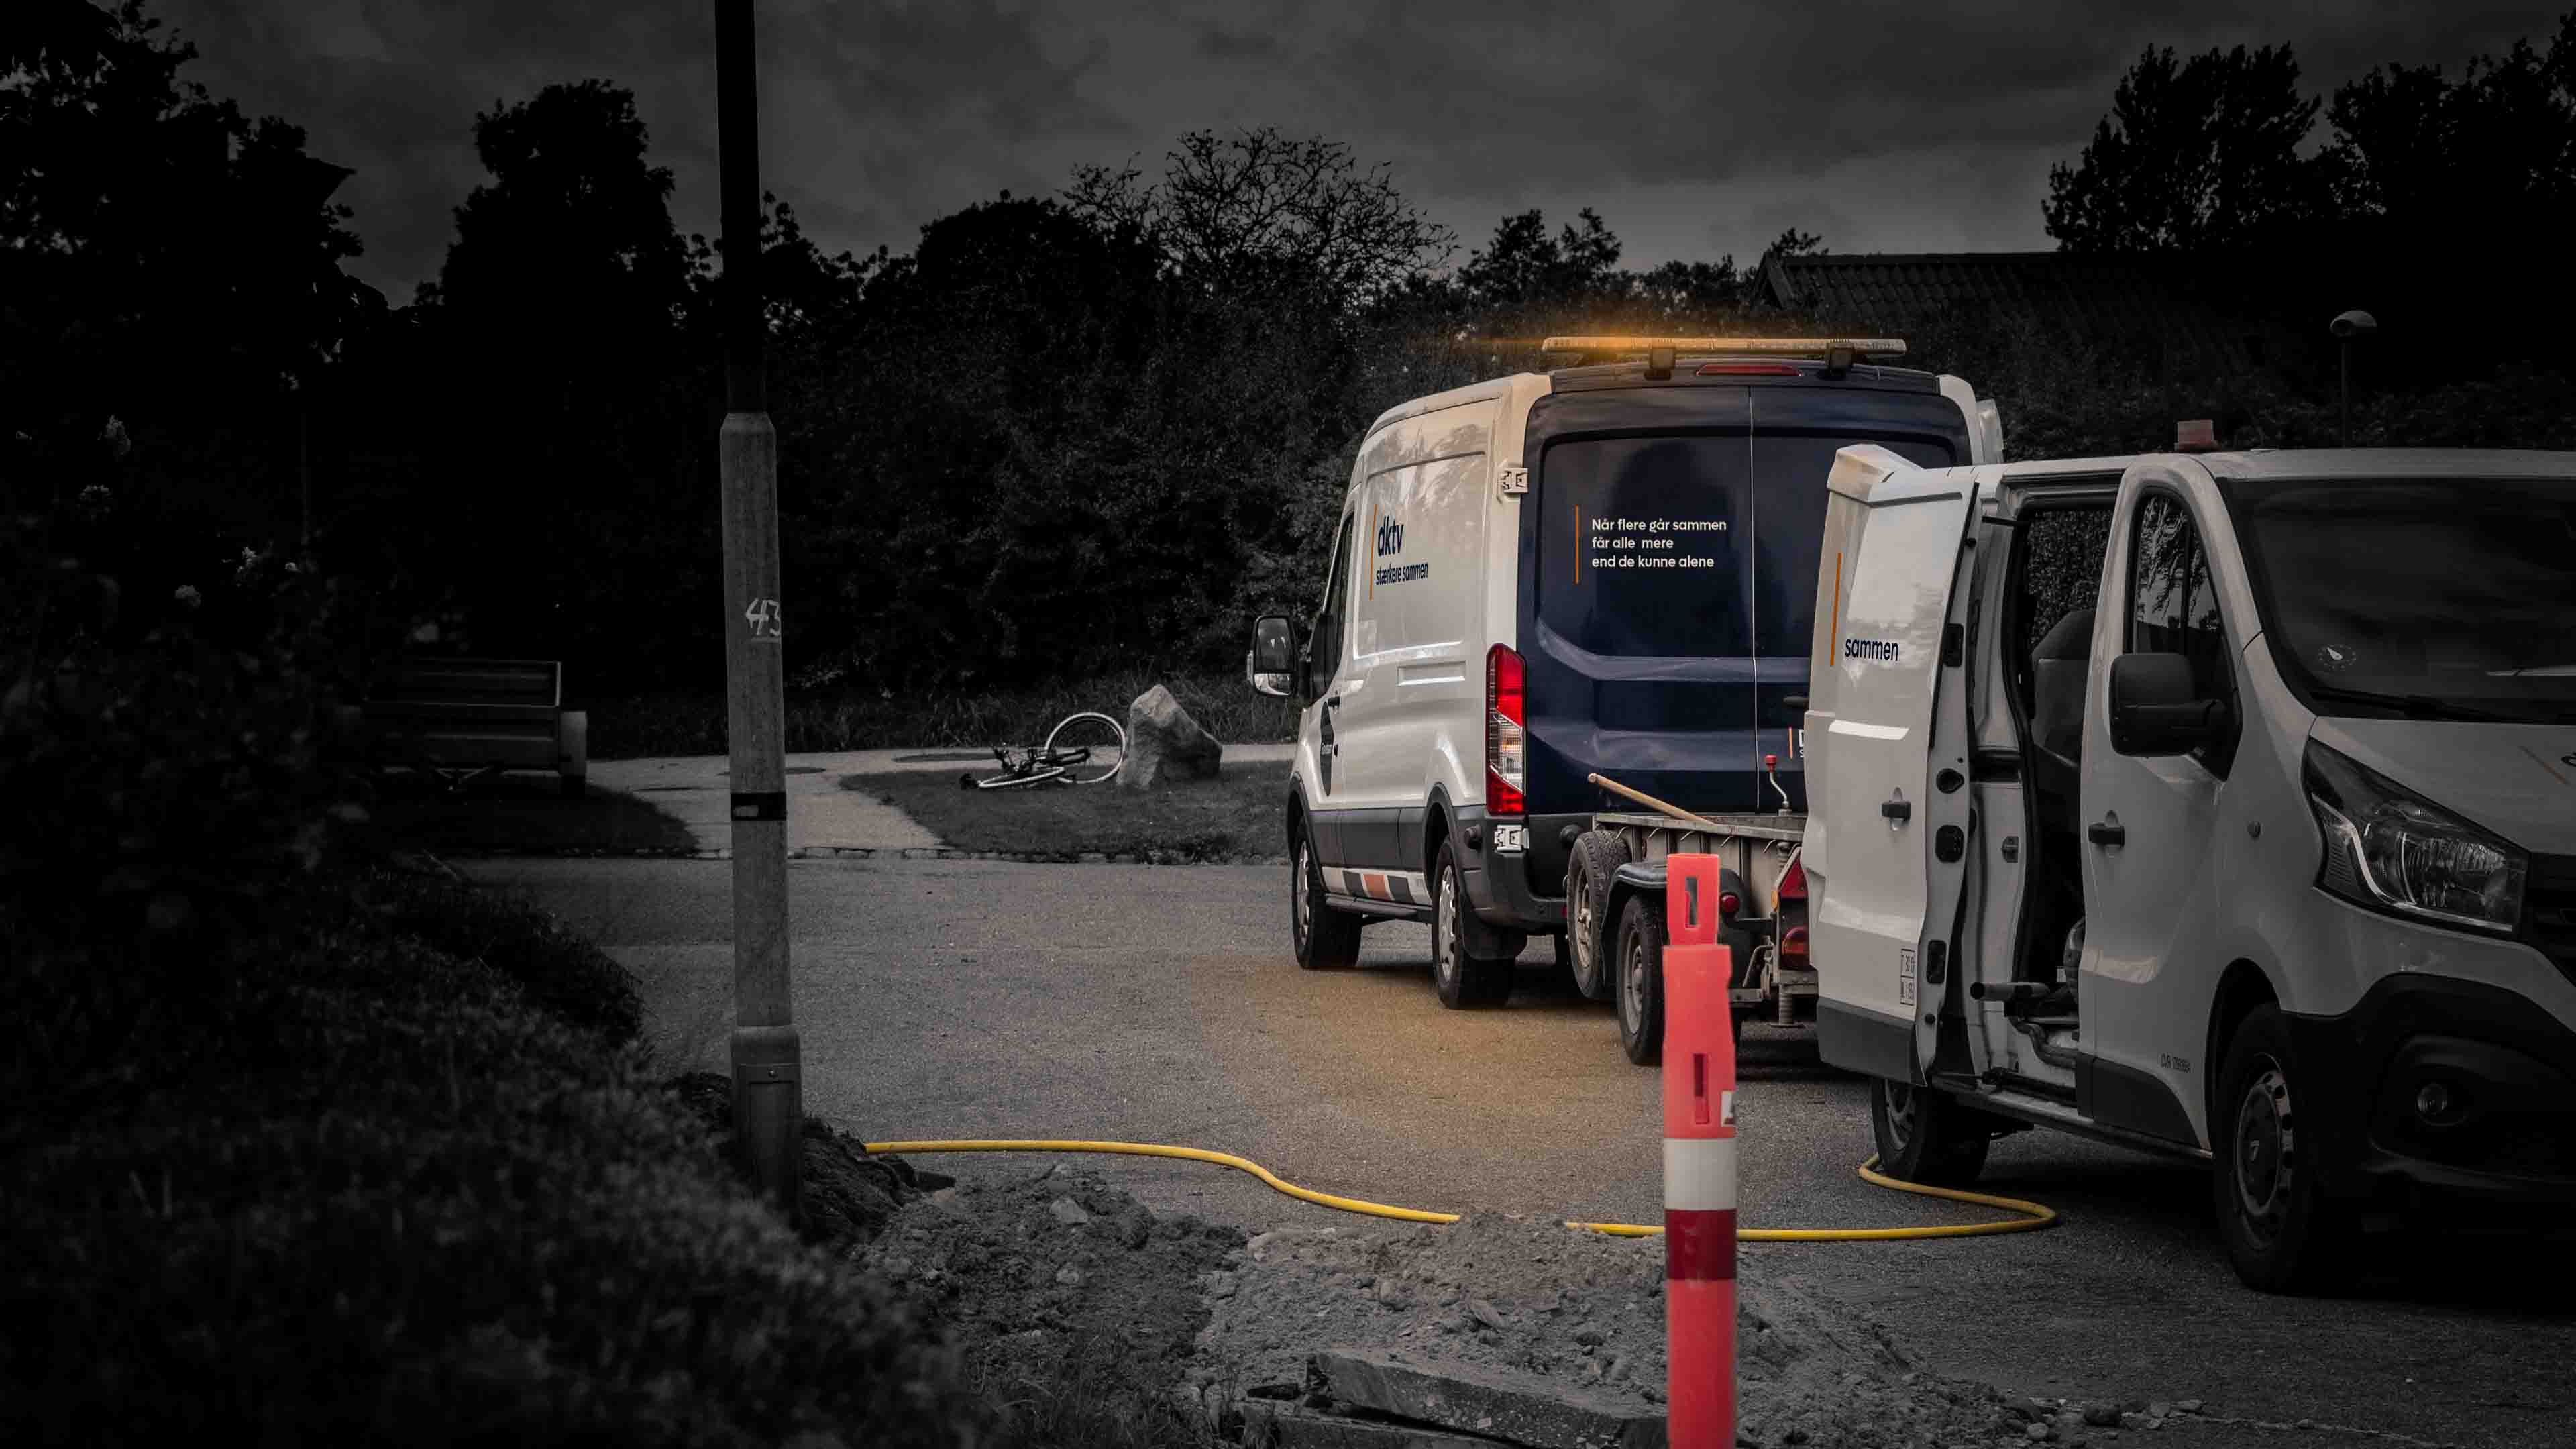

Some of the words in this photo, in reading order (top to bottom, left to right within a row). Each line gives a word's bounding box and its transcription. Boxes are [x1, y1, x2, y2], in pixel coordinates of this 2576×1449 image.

[1378, 515, 1404, 556] dktv
[1592, 518, 1615, 531] Når
[1617, 518, 1646, 531] flere
[1649, 518, 1670, 533] går
[1672, 521, 1727, 531] sammen
[1592, 537, 1610, 549] får
[1613, 537, 1635, 549] alle
[1642, 539, 1674, 549] mere
[1592, 555, 1616, 568] end
[1619, 555, 1635, 568] de
[1638, 555, 1676, 568] kunne
[1678, 555, 1714, 568] alene
[1376, 564, 1401, 586] stærkere
[1402, 562, 1428, 582] sammen
[745, 598, 781, 636] 43
[1845, 638, 1899, 661] sammen
